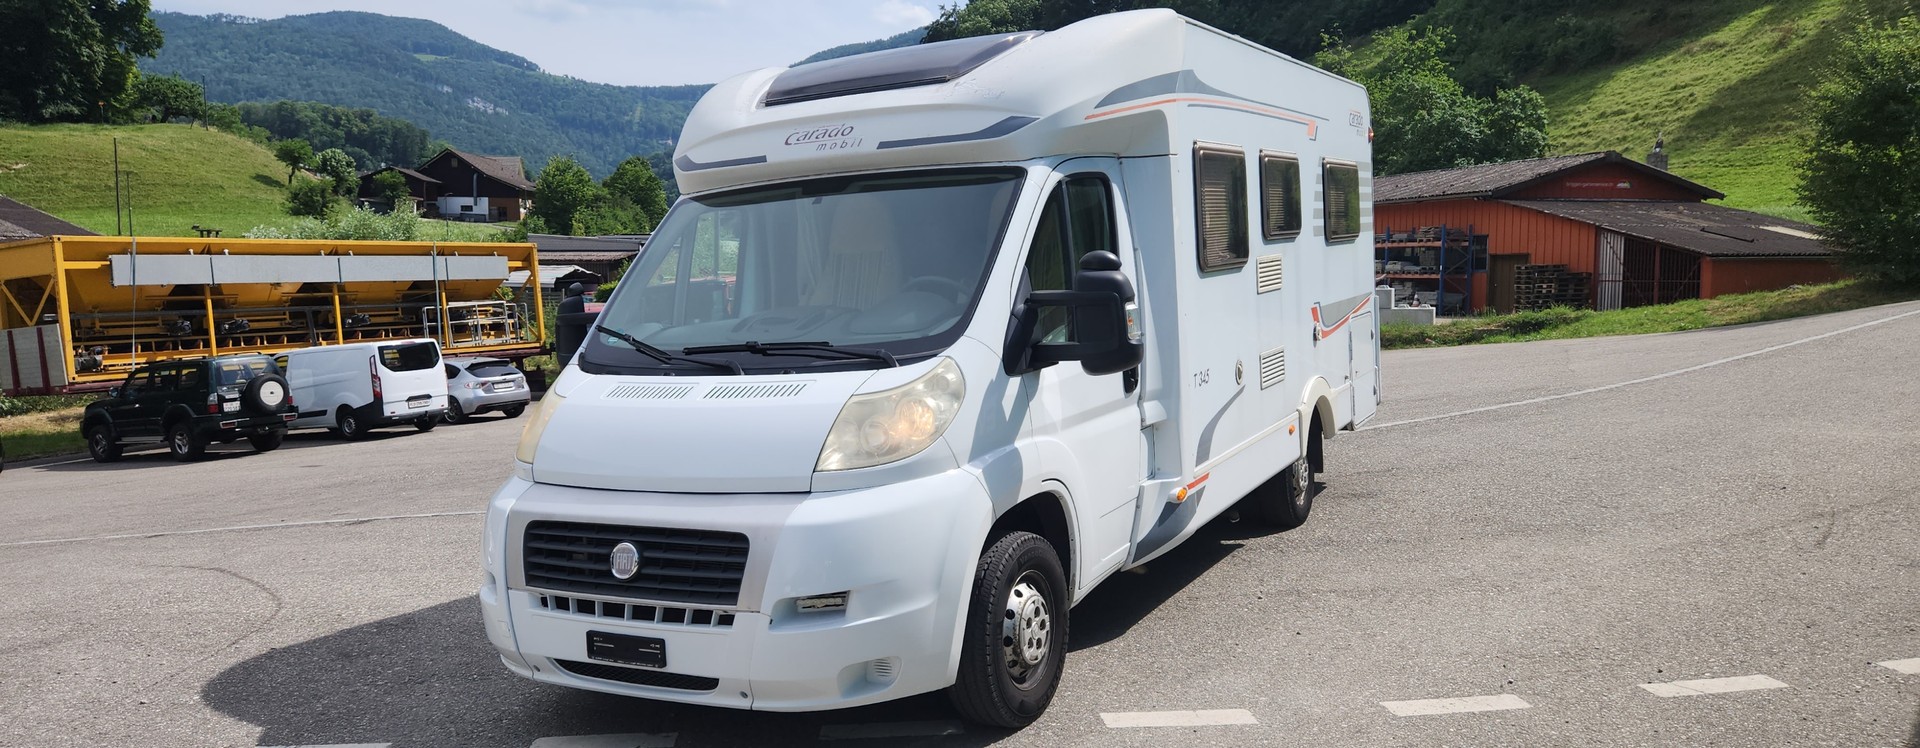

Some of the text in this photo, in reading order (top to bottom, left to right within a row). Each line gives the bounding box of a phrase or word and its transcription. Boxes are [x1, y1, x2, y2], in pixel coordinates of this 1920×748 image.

[815, 138, 863, 151] mobil
[1193, 368, 1210, 388] T 345
[616, 553, 633, 570] FIAT
